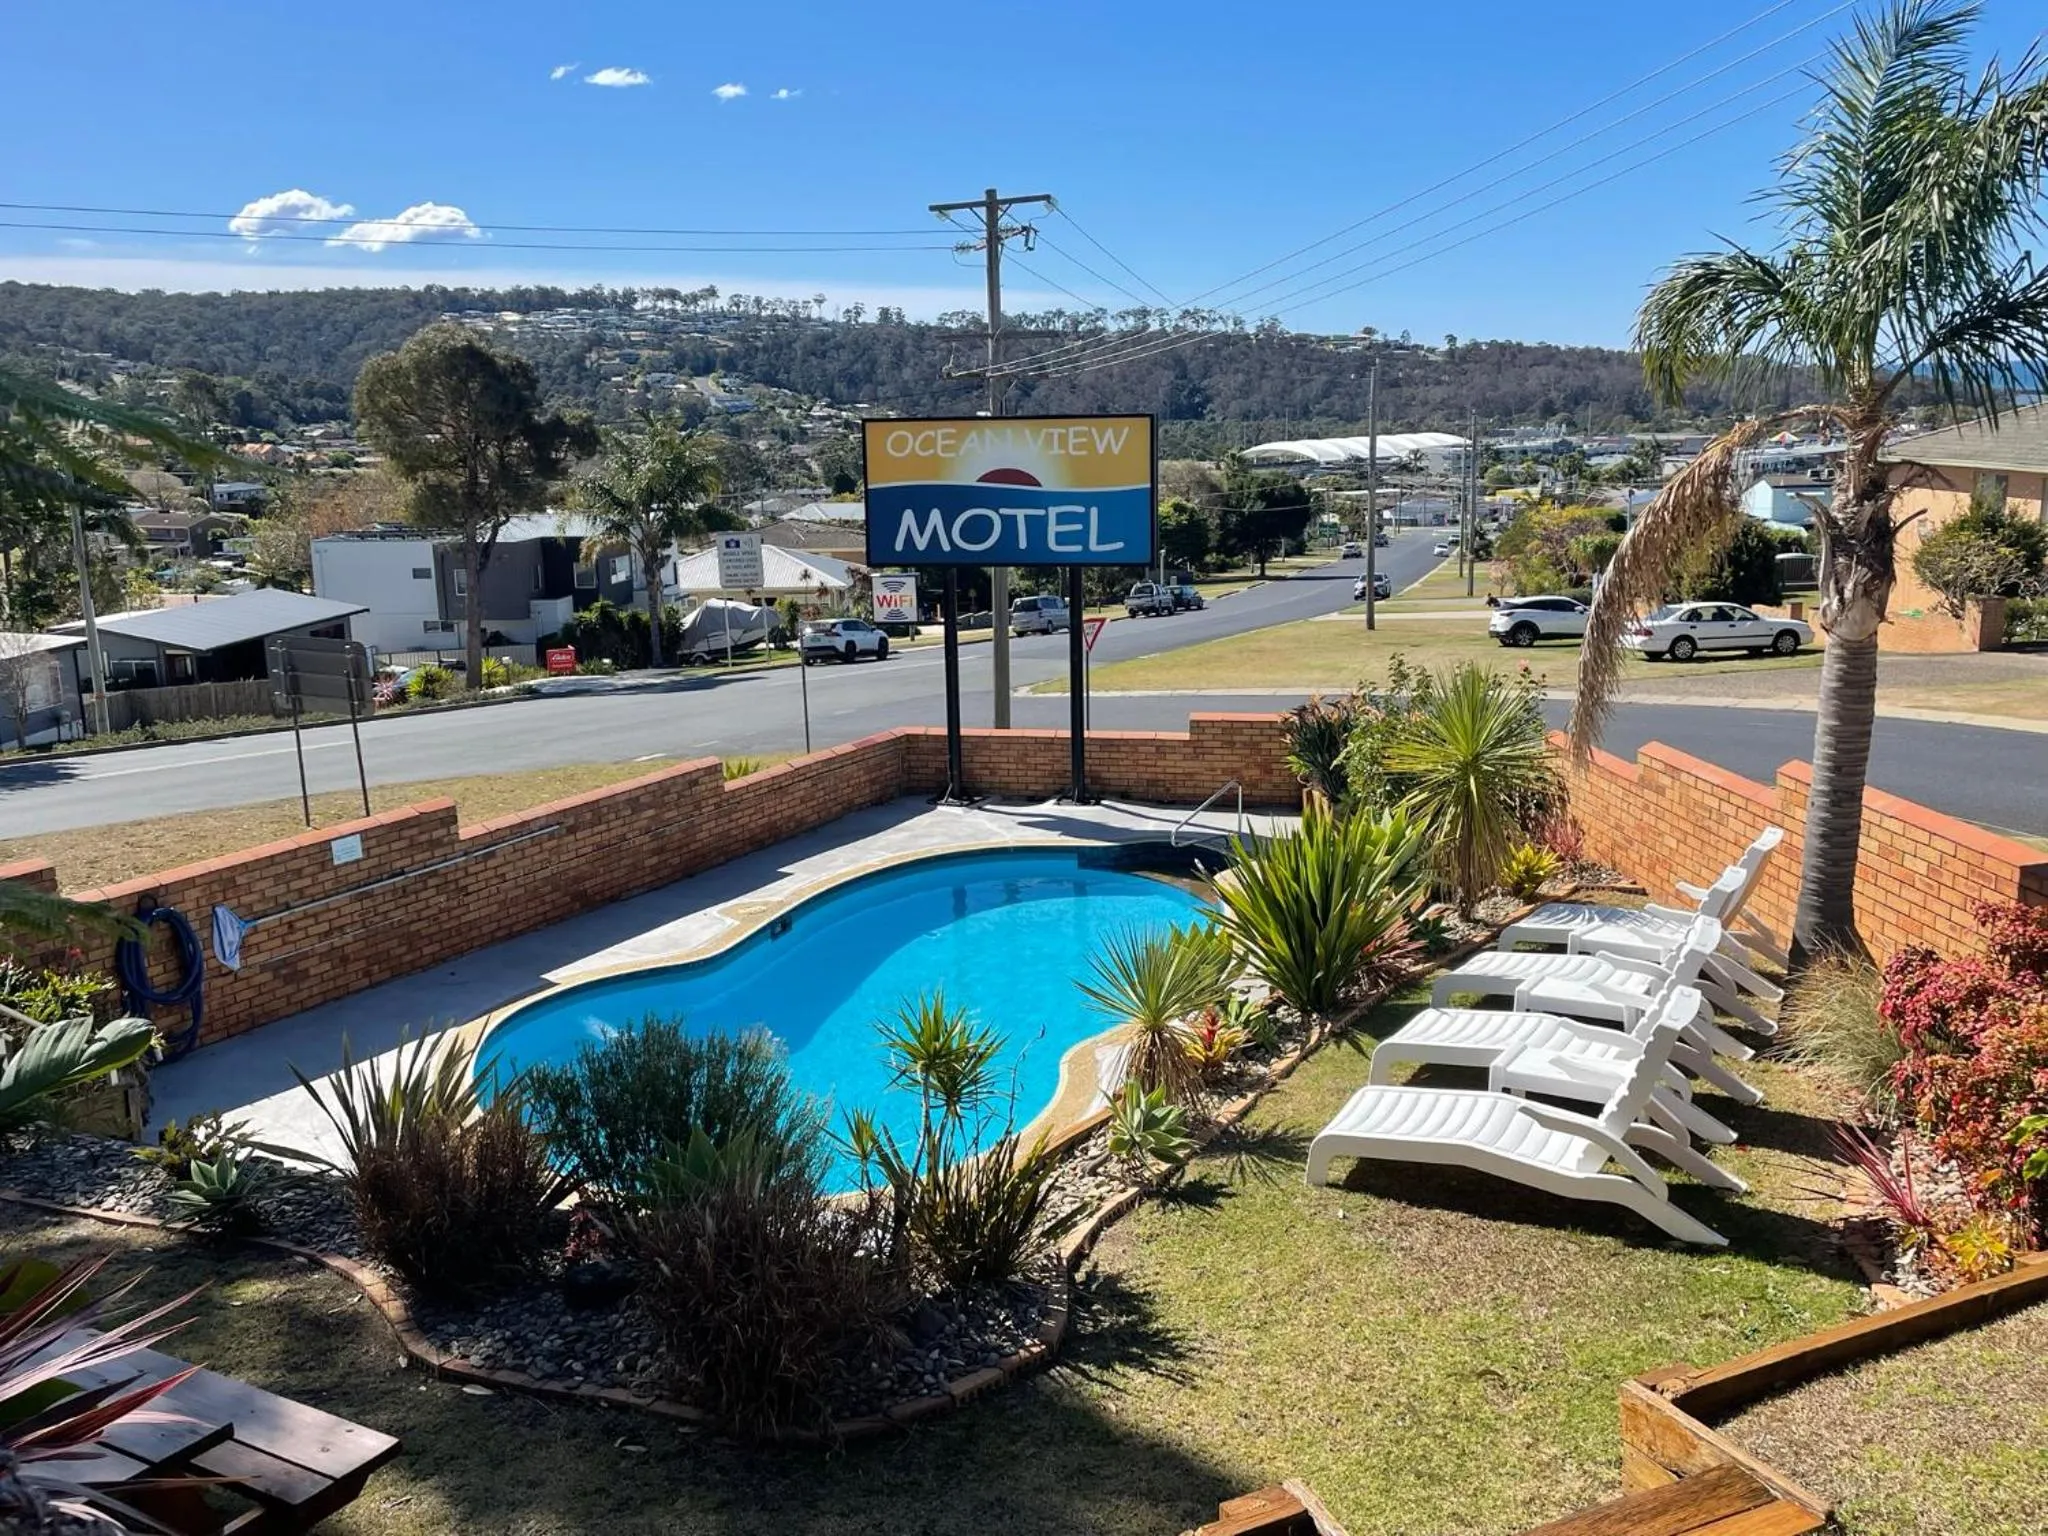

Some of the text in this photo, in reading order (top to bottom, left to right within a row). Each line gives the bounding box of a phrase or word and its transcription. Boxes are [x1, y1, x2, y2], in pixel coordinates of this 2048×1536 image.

[886, 425, 1130, 458] OCEAN VIEW
[894, 505, 1125, 553] MOTEL
